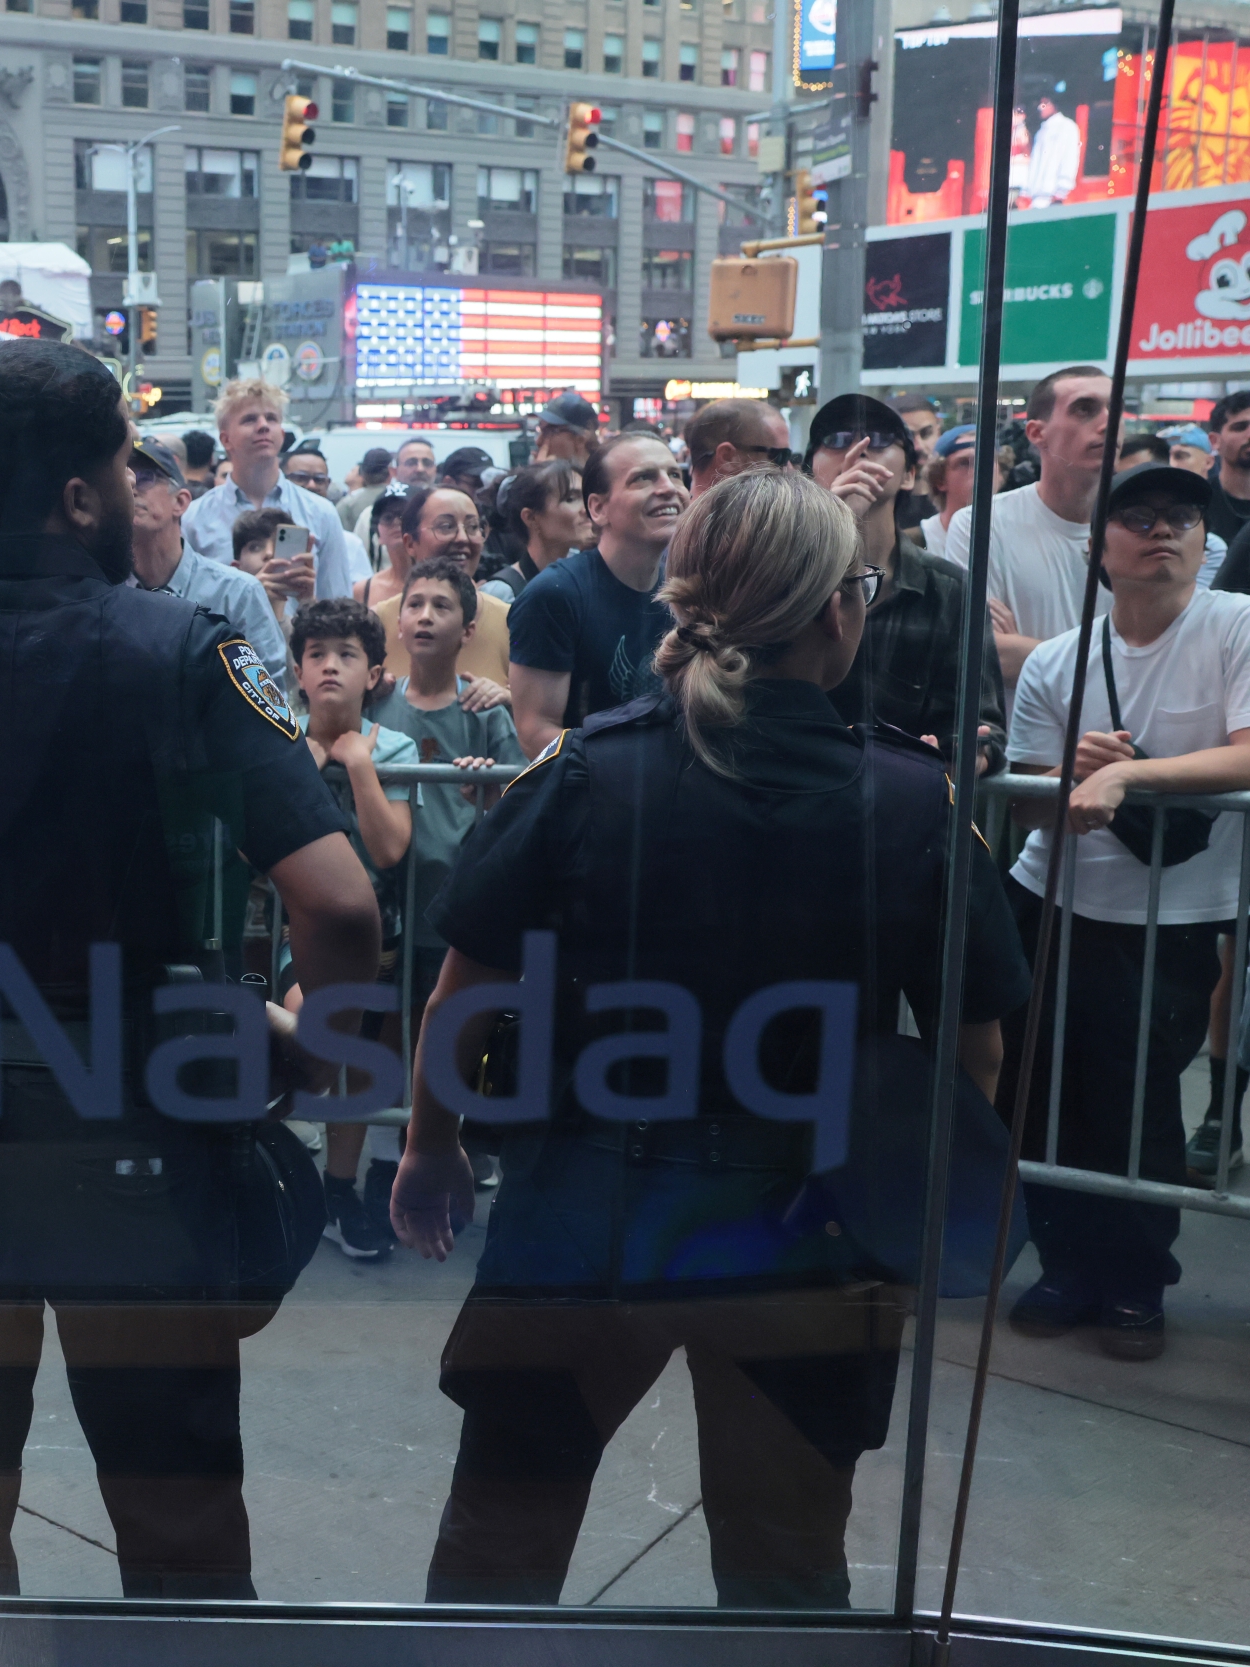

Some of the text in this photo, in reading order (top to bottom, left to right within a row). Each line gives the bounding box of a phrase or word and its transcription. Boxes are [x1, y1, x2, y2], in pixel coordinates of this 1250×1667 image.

[969, 282, 1073, 306] SRBUCKS
[242, 681, 280, 720] CITY OF
